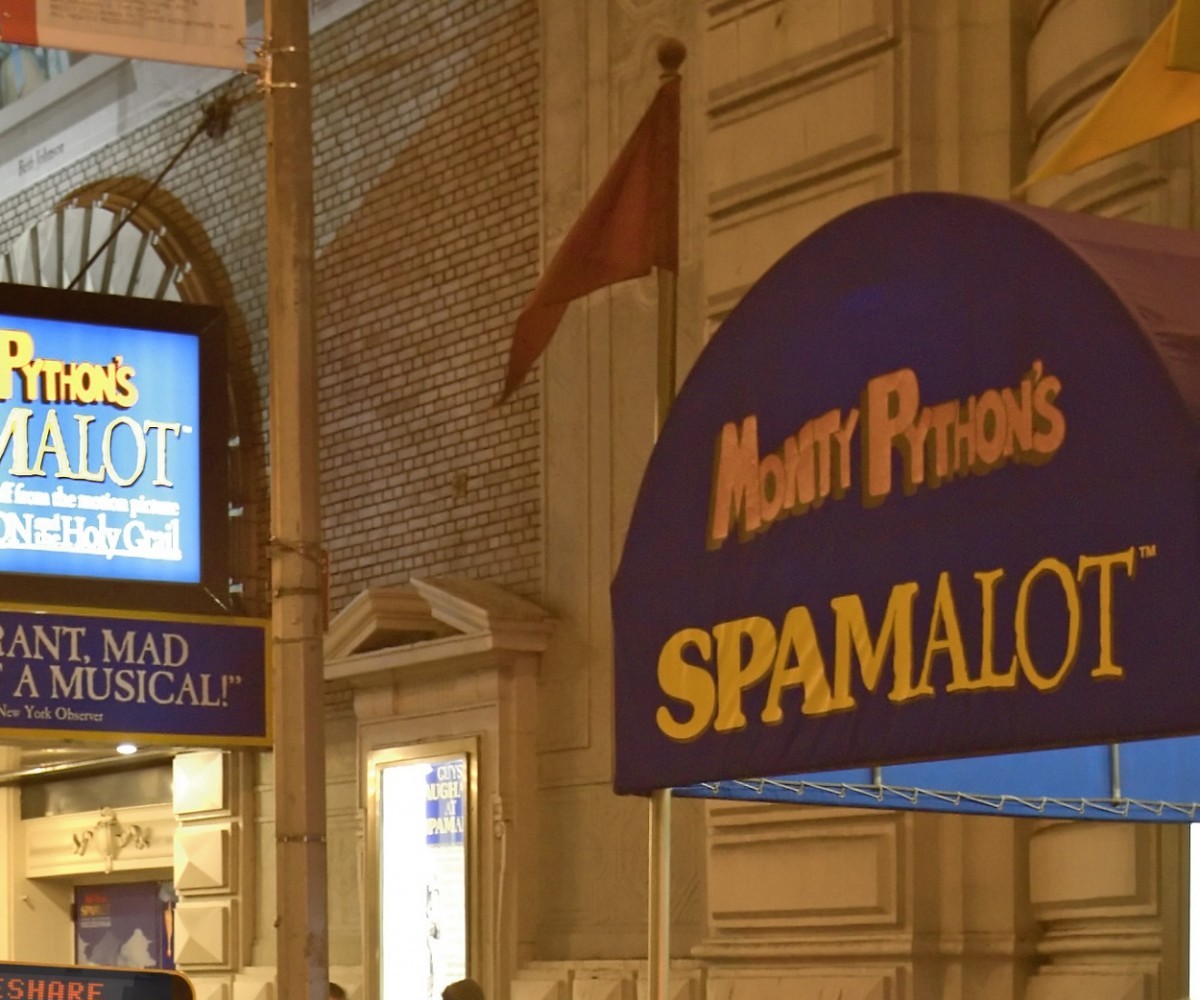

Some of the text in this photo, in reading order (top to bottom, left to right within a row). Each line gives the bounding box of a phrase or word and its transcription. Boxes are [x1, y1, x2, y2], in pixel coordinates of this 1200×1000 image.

[706, 359, 1067, 551] MONTY PYTHON'S
[52, 485, 78, 508] the
[61, 513, 121, 559] Holy
[123, 518, 180, 556] Grail
[103, 629, 190, 668] MAD
[656, 546, 1136, 743] SPAMALOT
[15, 666, 40, 697] A
[24, 706, 52, 720] York
[55, 707, 104, 722] Observer
